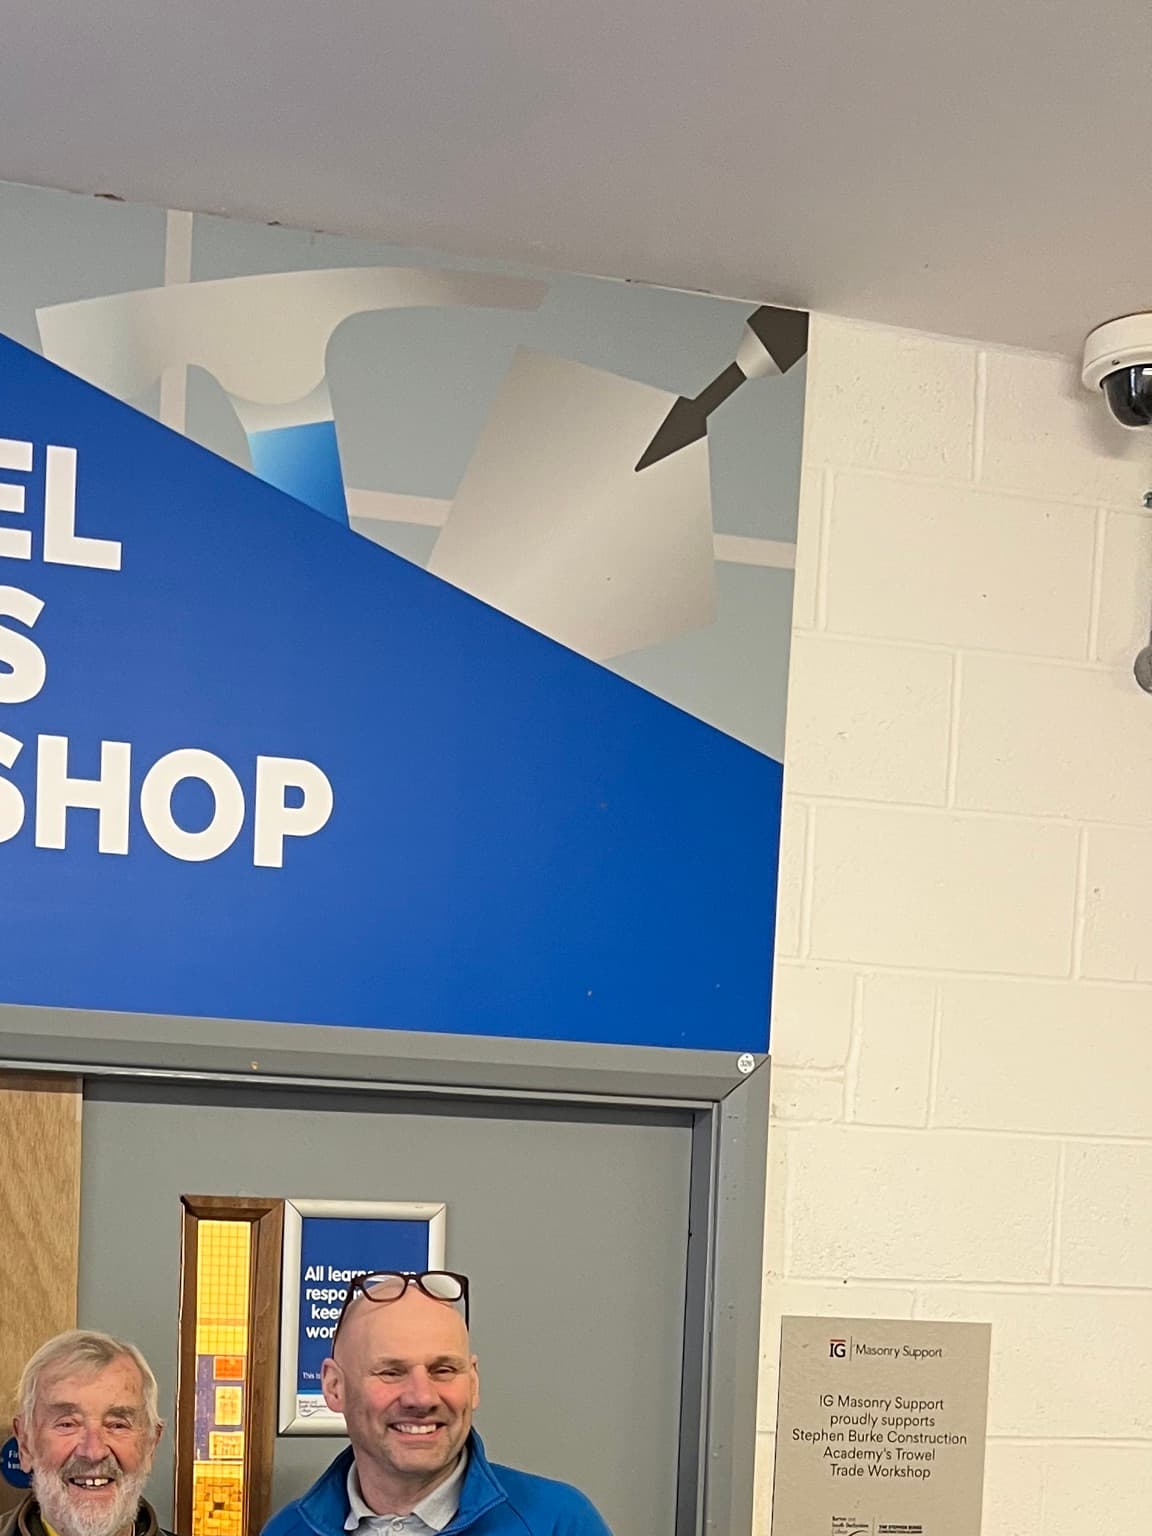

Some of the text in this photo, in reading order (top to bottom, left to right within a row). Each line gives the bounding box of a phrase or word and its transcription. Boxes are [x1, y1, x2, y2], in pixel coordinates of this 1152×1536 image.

[304, 1265, 324, 1282] All
[829, 1343, 943, 1359] IG Masonry Support
[819, 1394, 944, 1413] IG Masonry Support
[830, 1413, 936, 1430] proudly supports
[792, 1428, 967, 1445] Stephen Burke Construction
[823, 1446, 936, 1463] Academy's Trowel
[830, 1463, 931, 1481] Trade Workshop
